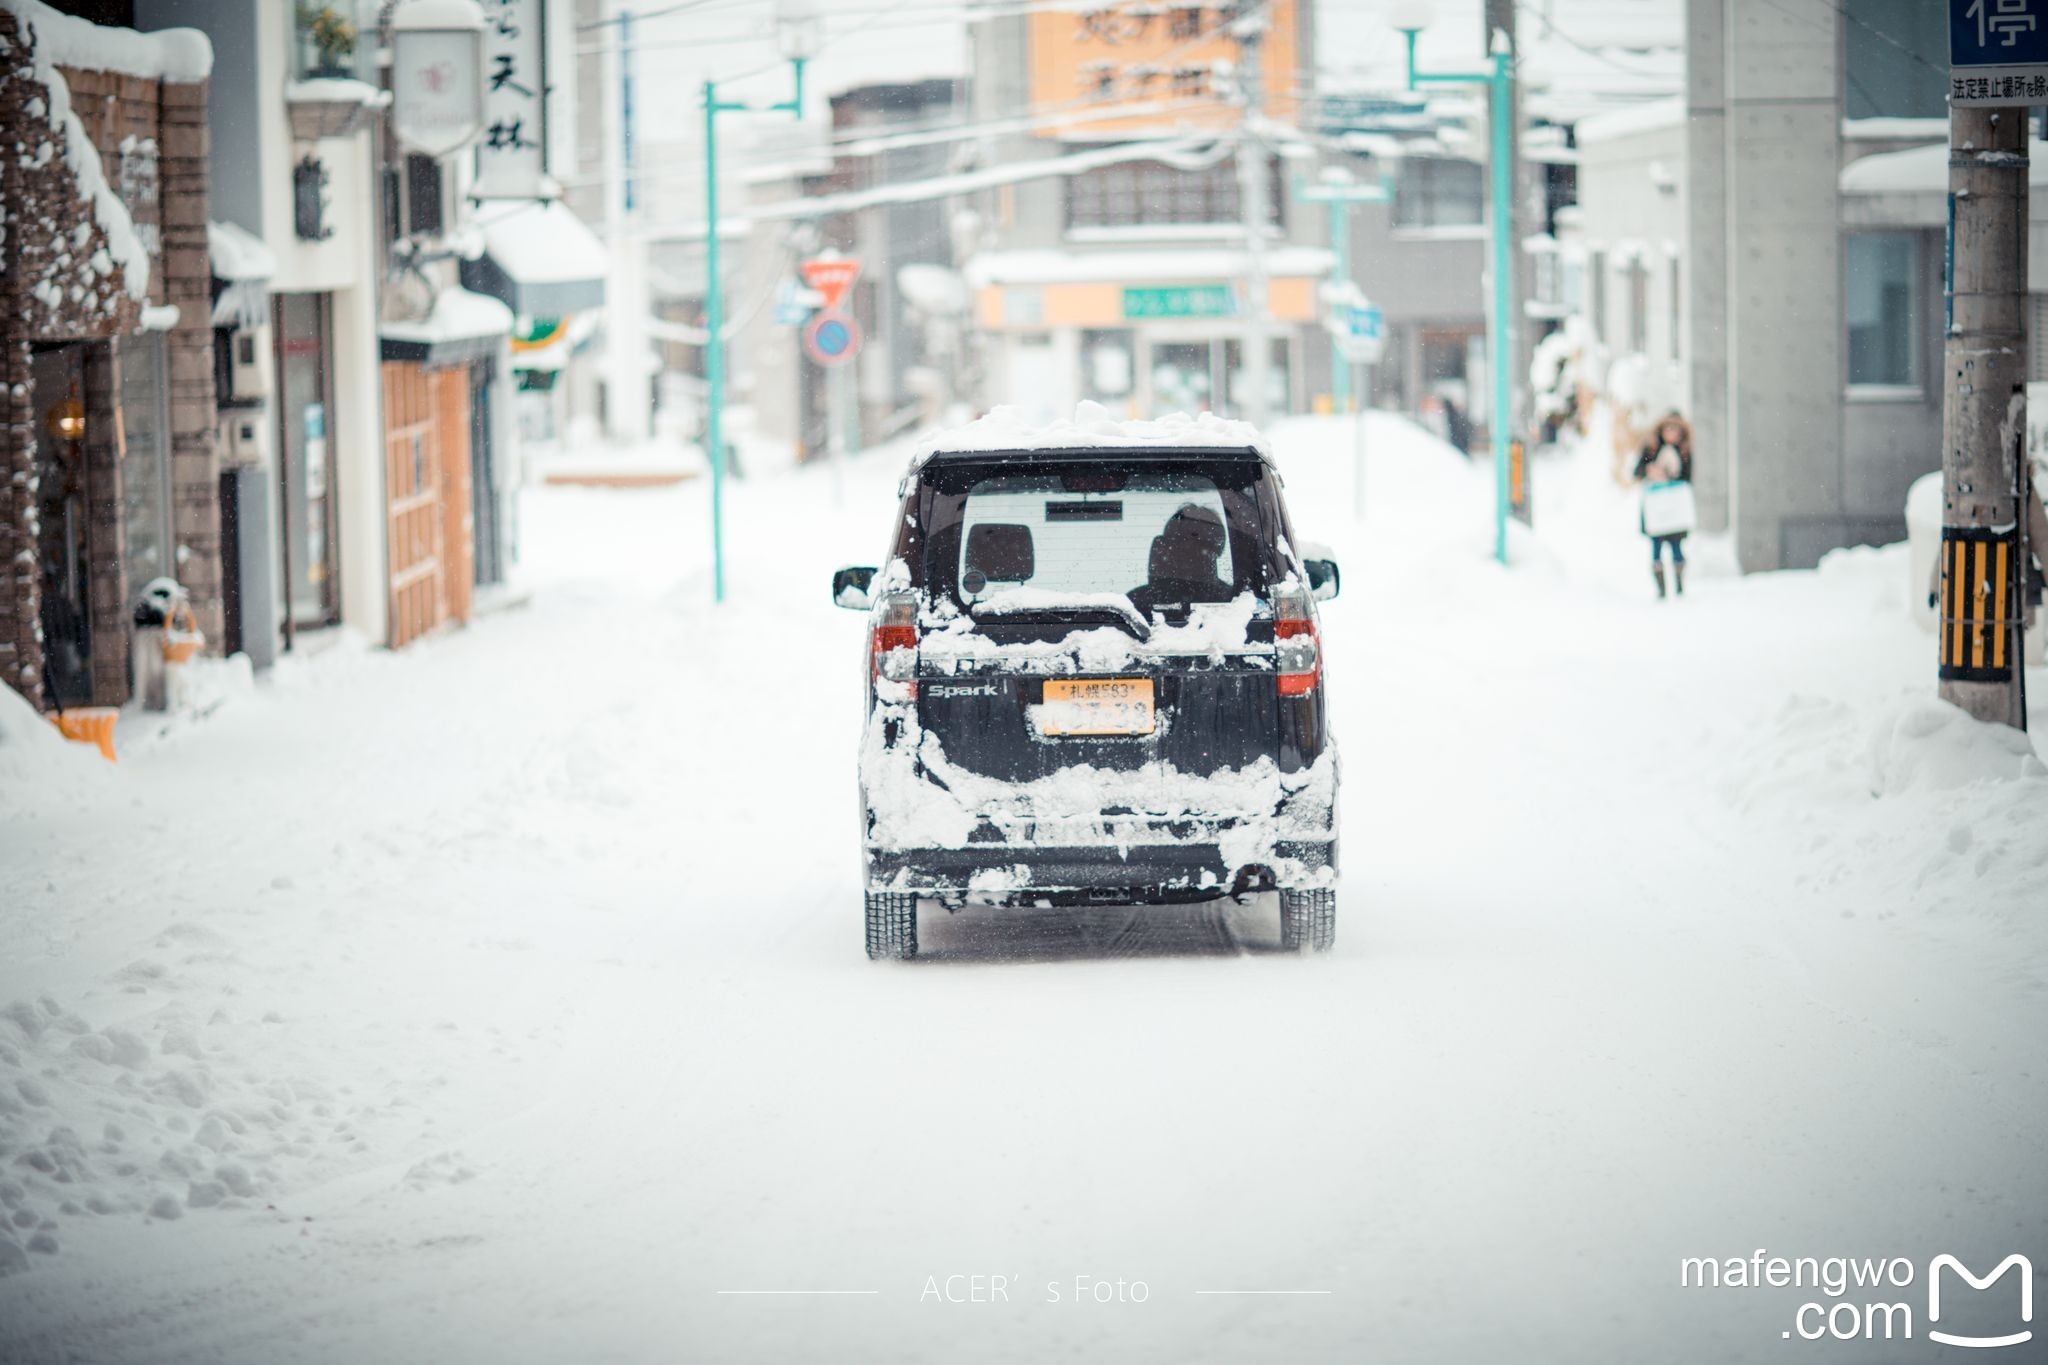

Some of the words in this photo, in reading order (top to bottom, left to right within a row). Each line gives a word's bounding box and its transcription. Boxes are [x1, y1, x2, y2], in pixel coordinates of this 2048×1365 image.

[1965, 0, 2036, 47] 停
[1952, 75, 2048, 99] 法定禁止場所を除
[928, 684, 998, 698] Spark
